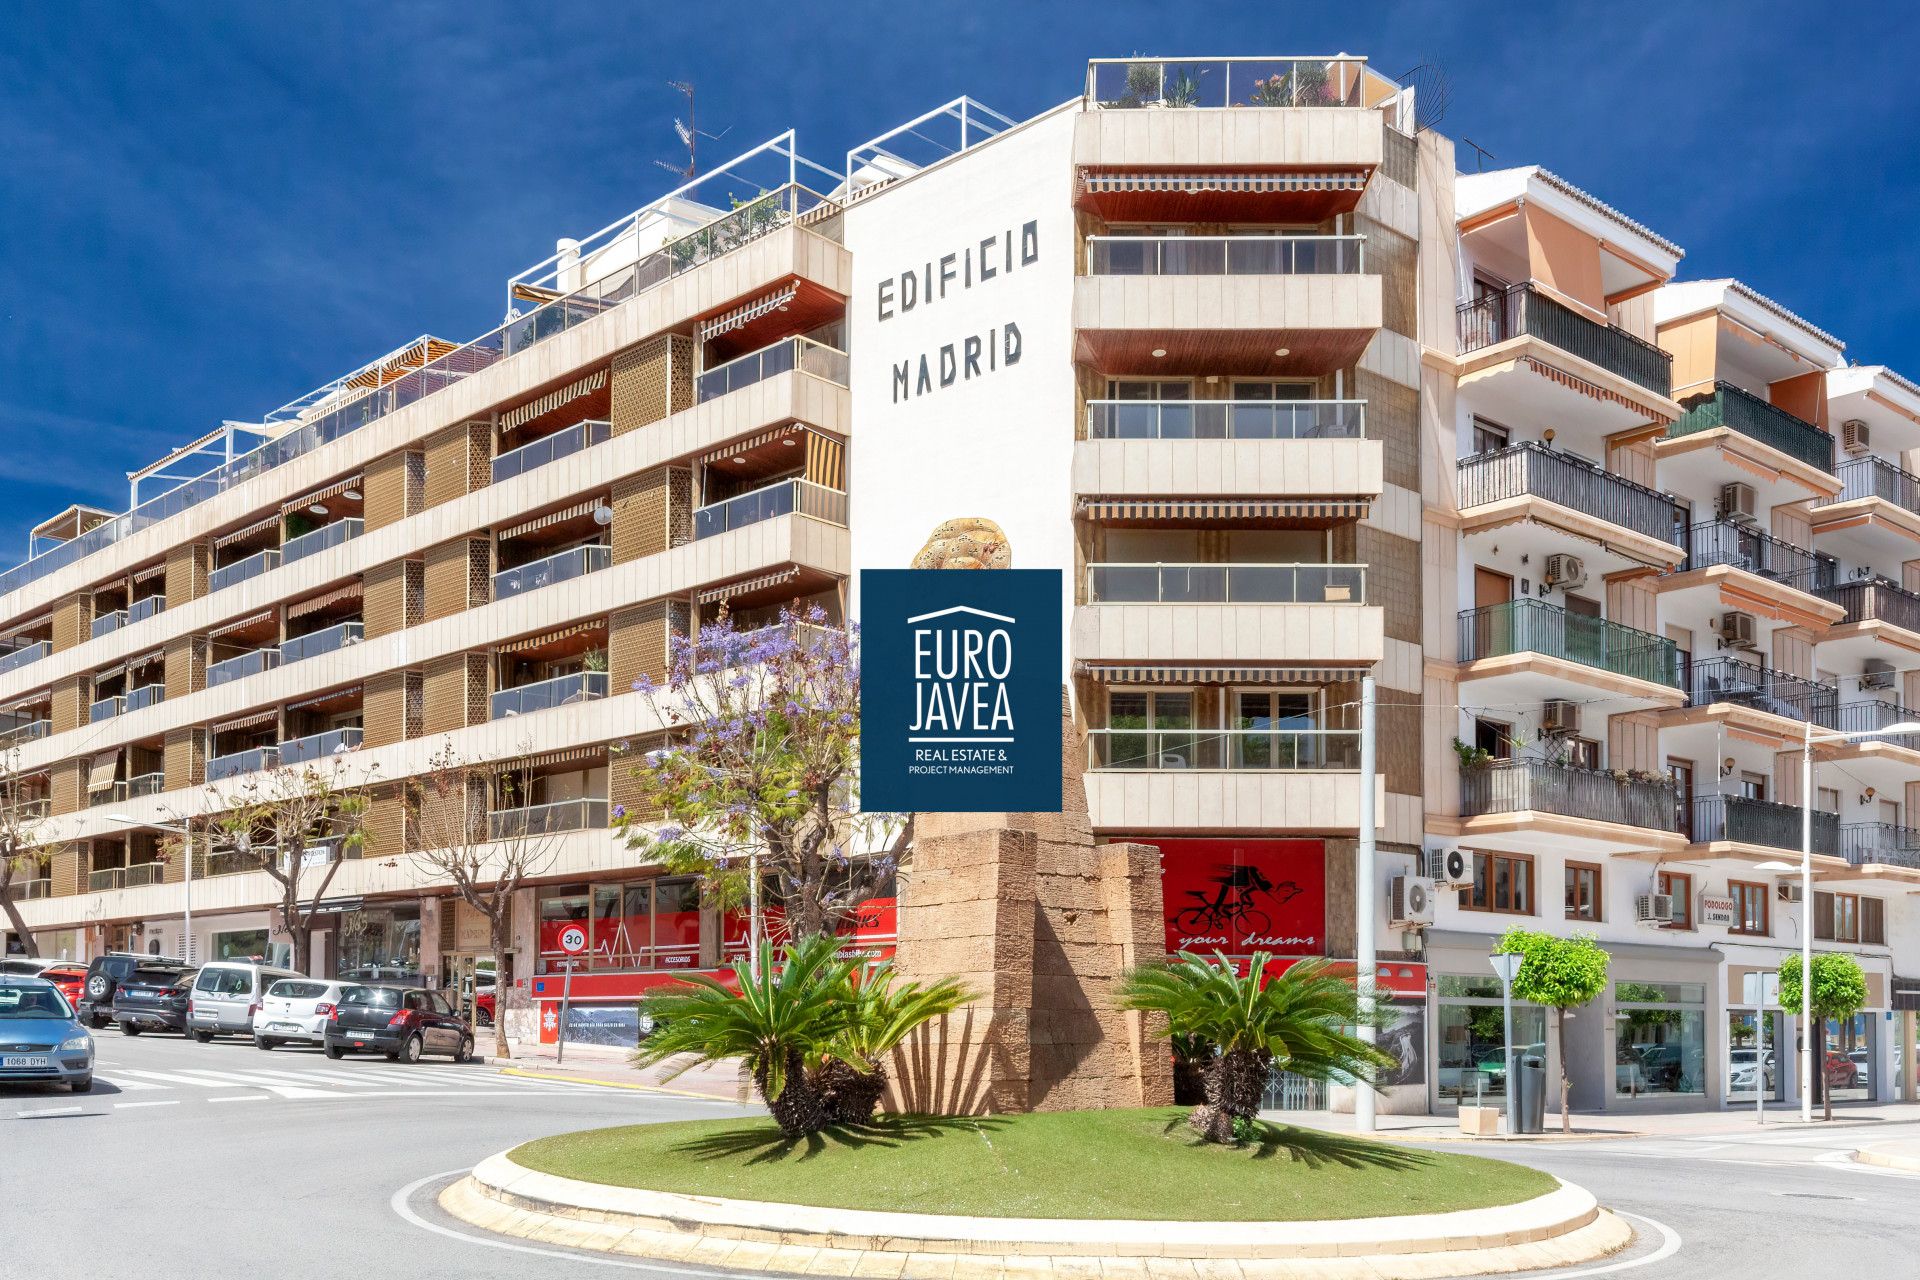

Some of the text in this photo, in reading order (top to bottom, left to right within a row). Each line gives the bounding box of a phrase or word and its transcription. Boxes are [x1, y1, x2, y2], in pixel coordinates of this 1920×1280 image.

[878, 219, 1039, 323] EDIFICIO
[892, 321, 1023, 404] MADRID
[1704, 899, 1733, 911] PODOLOGO
[565, 934, 582, 945] 30
[1178, 931, 1316, 950] your dreams
[30, 1057, 46, 1066] DYH
